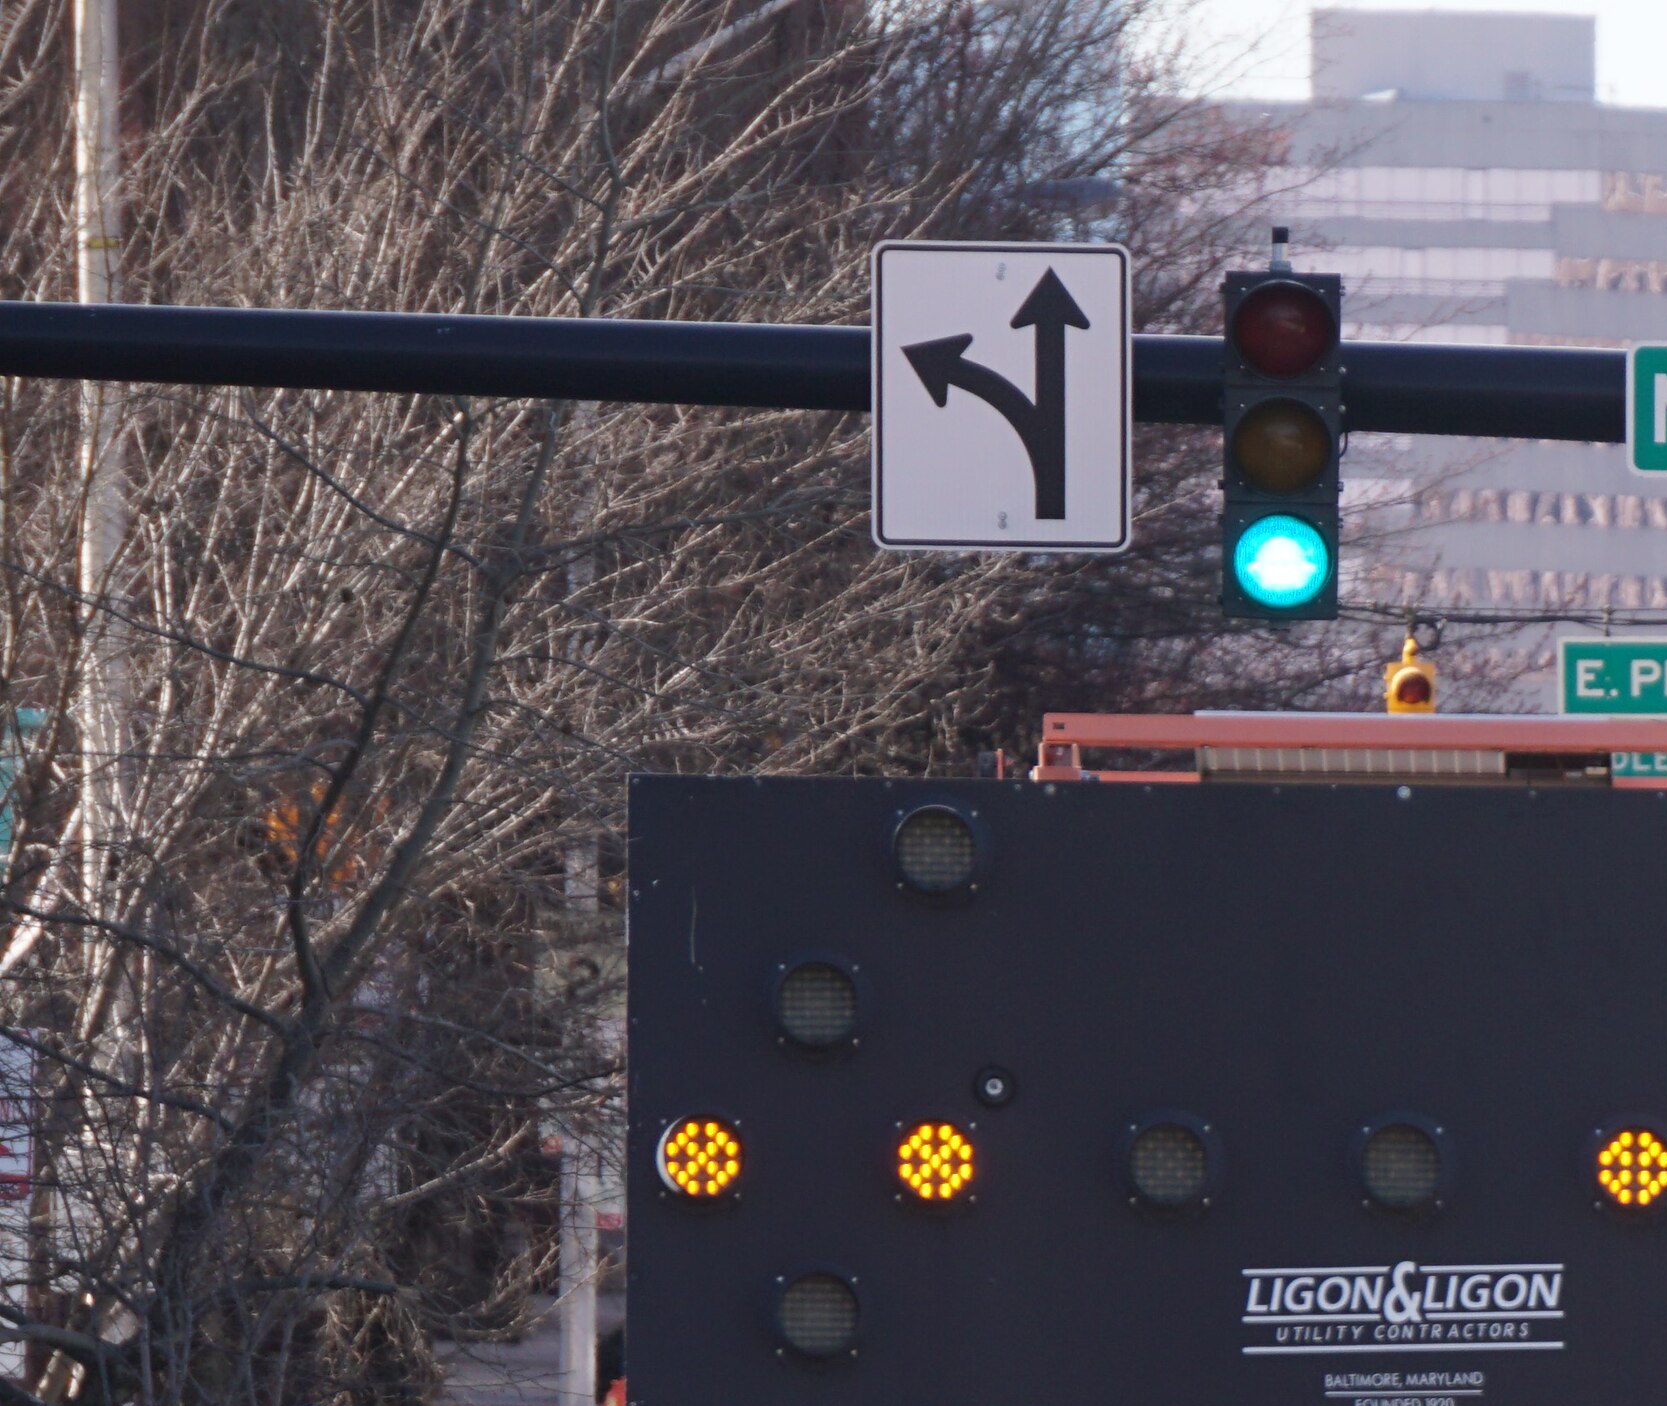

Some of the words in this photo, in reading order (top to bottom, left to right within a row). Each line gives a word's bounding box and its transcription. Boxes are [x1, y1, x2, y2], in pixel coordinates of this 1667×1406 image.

[1576, 659, 1619, 697] E.
[1275, 1324, 1364, 1343] UTILITY
[1374, 1321, 1530, 1341] CONTRACTORS
[1324, 1372, 1402, 1388] BALTIMORE,
[1405, 1371, 1484, 1386] MARYLAND
